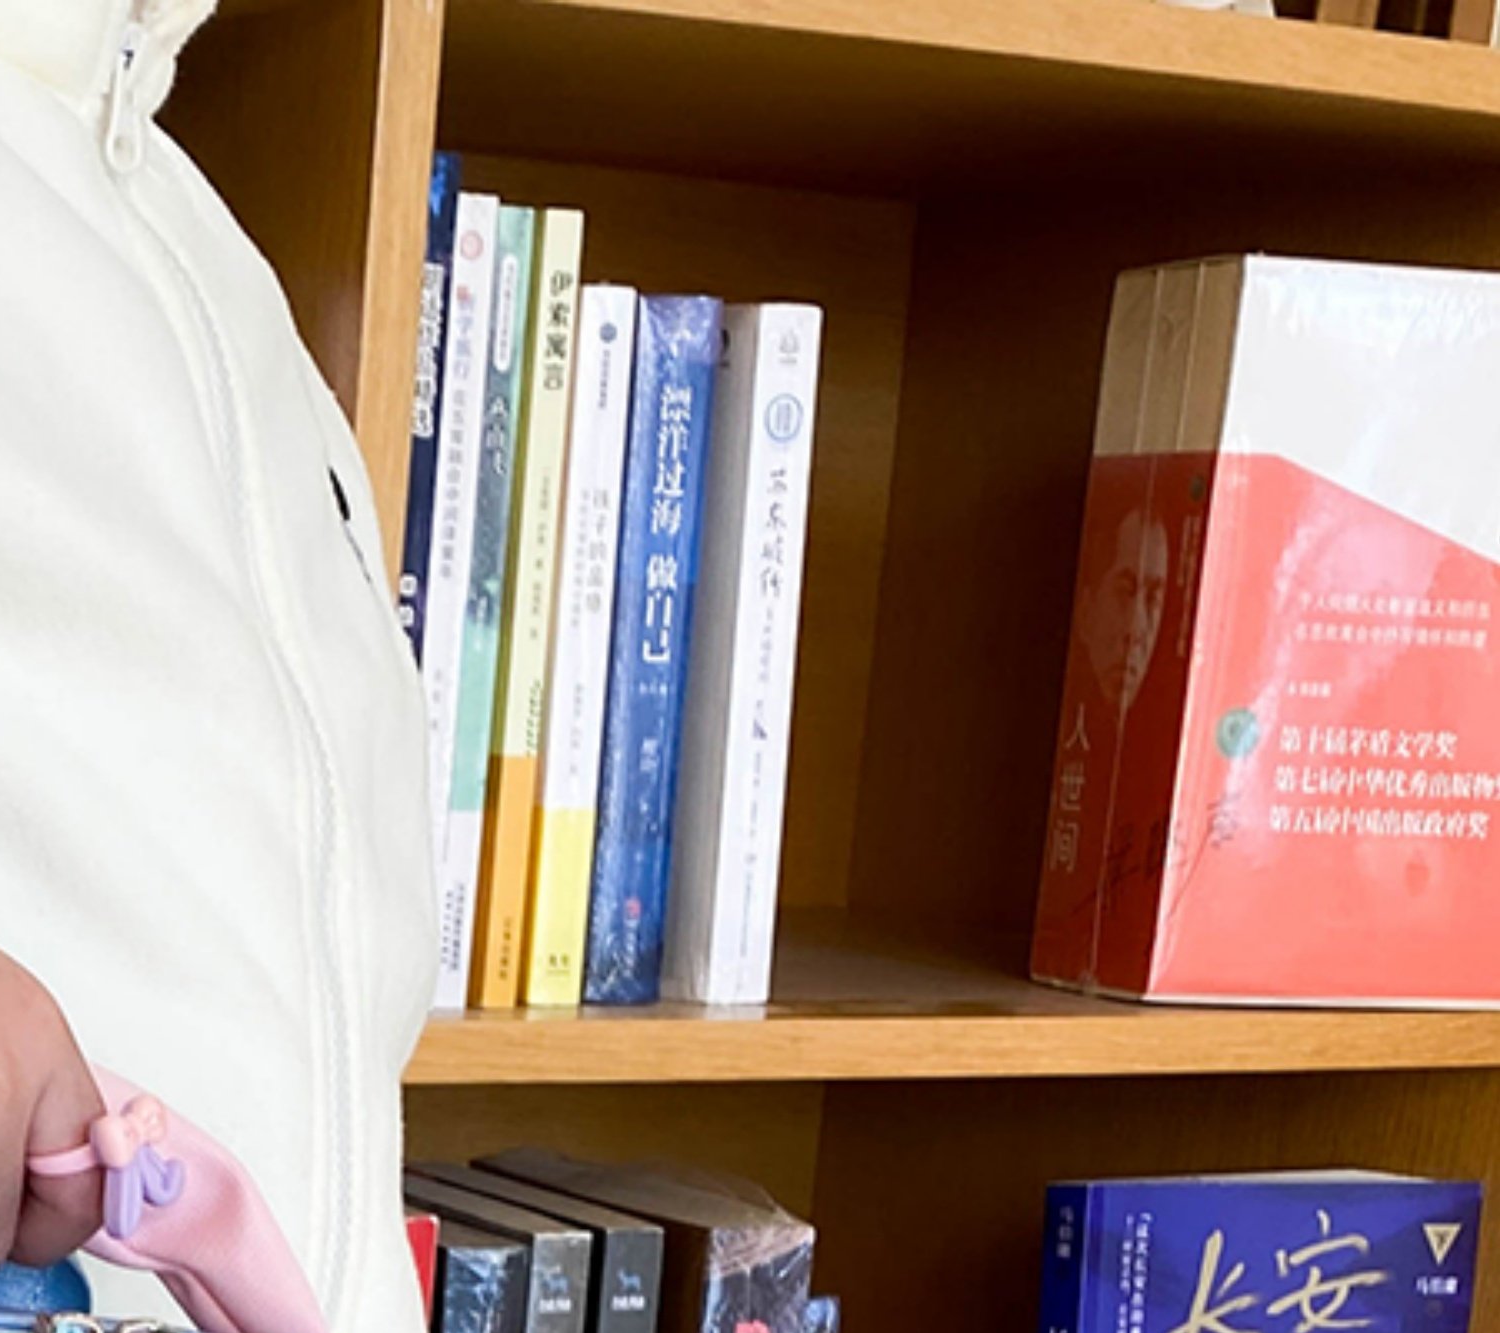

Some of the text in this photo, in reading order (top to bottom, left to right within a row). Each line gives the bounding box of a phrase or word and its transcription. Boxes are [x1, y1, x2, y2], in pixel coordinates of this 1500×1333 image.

[641, 553, 678, 663] 做自己
[1051, 703, 1090, 873] 人世间
[1279, 725, 1458, 760] 第十届茅盾文学奖
